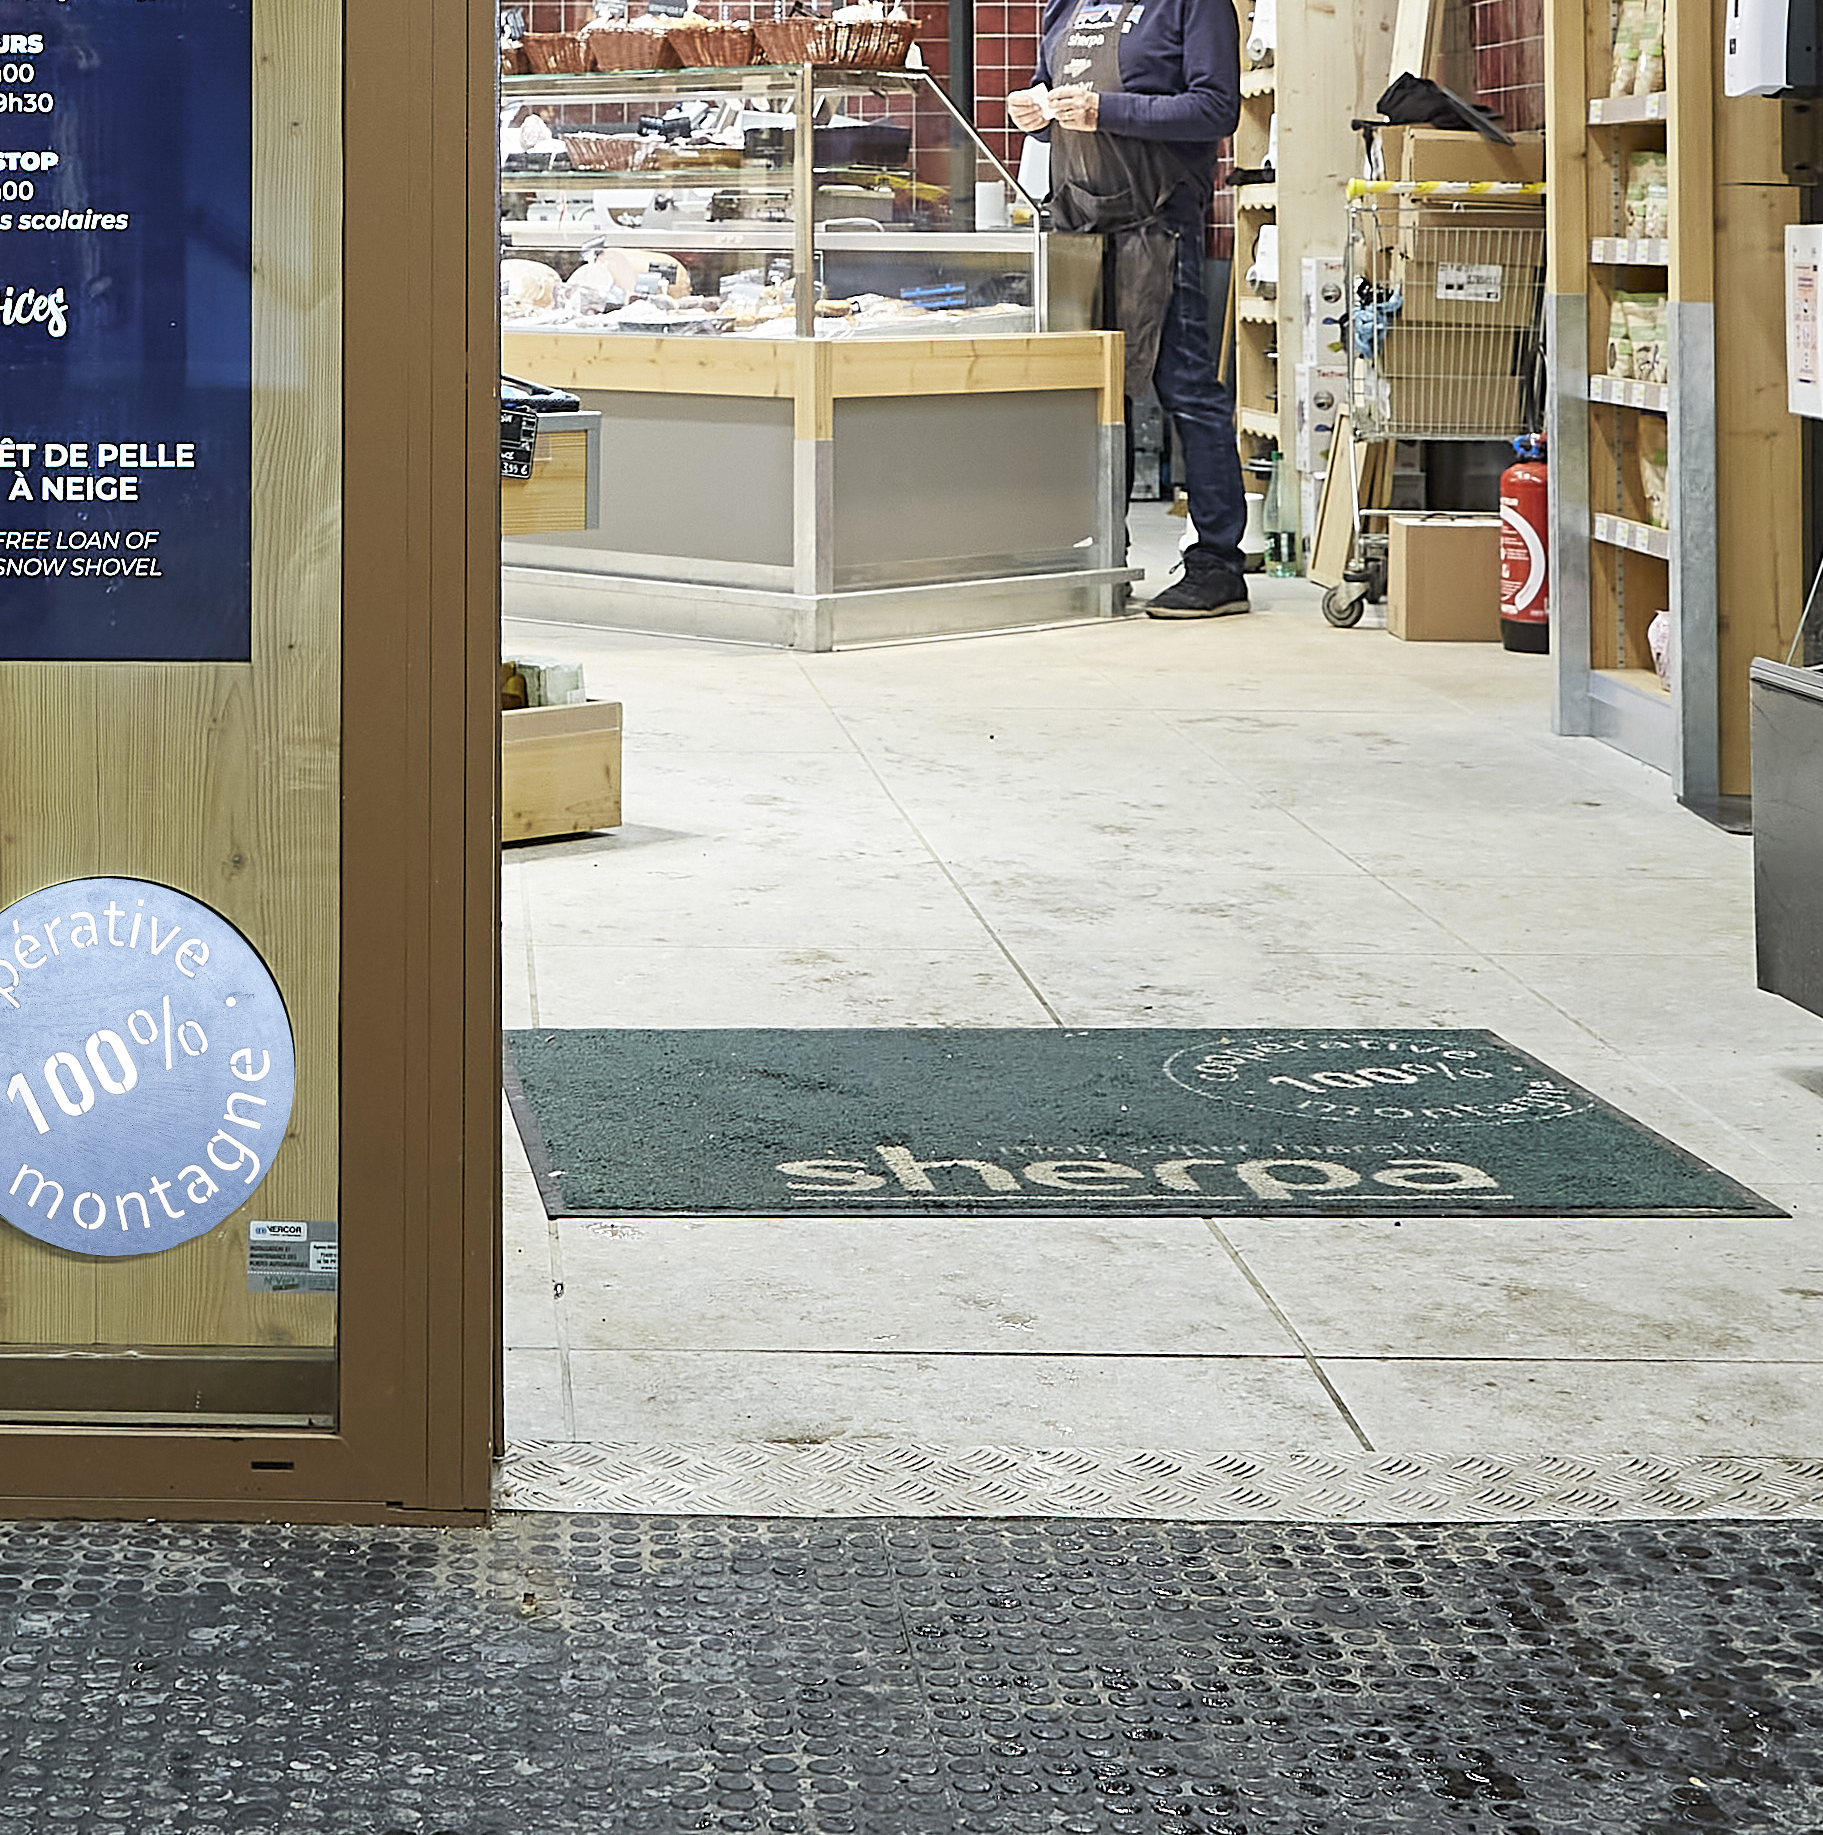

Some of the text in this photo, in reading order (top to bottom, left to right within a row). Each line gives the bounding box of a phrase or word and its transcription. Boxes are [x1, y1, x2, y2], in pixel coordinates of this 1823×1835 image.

[18, 210, 129, 232] scolaires
[45, 444, 89, 468] DE
[97, 444, 196, 468] PELLE
[8, 472, 139, 502] À NEIGE
[55, 531, 120, 551] LOAN
[125, 531, 160, 551] OF
[70, 557, 163, 578] SHOVEL
[6, 994, 209, 1135] 100%
[8, 1046, 271, 1231] montagne
[776, 1143, 1498, 1199] sherpa
